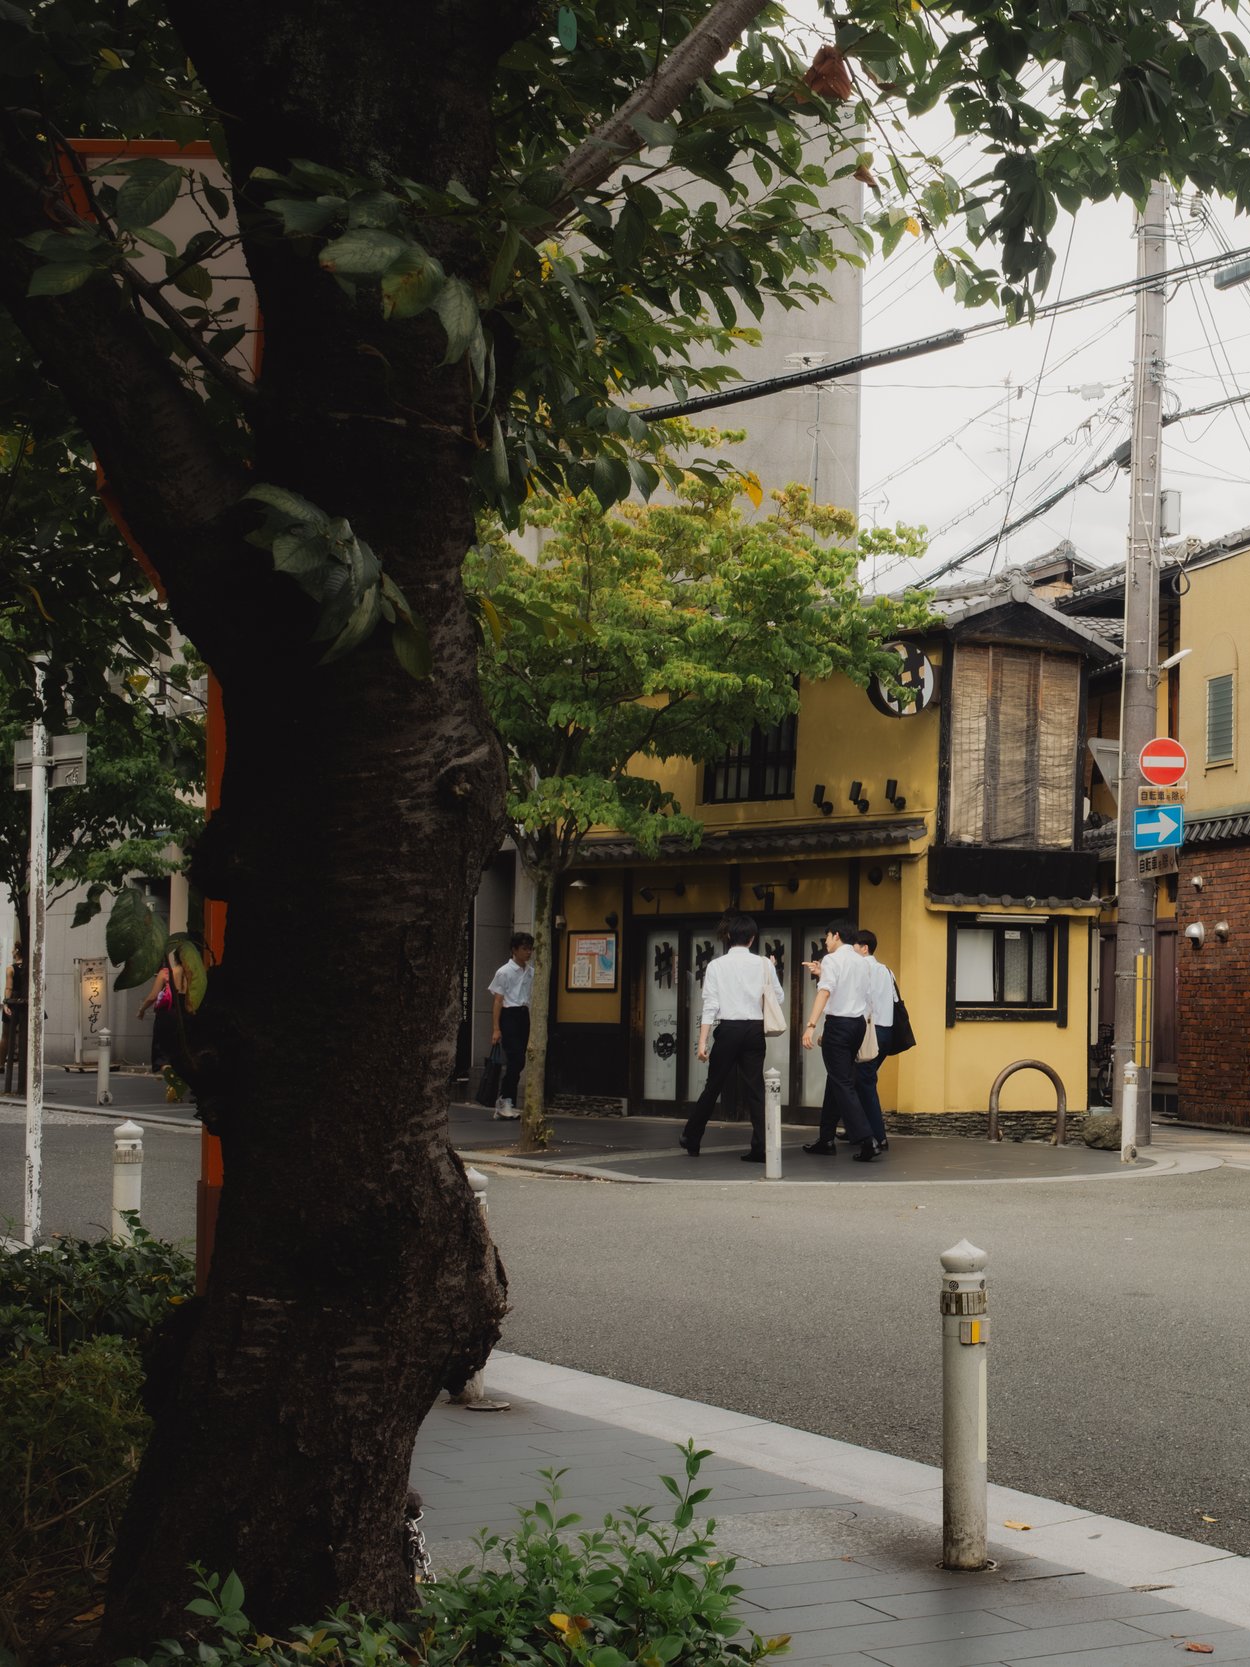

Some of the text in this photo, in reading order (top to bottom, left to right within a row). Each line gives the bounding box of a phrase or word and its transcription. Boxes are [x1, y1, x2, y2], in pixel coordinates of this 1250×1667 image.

[1141, 791, 1185, 801] 自転車を除く
[88, 986, 102, 1034] ろくでなし
